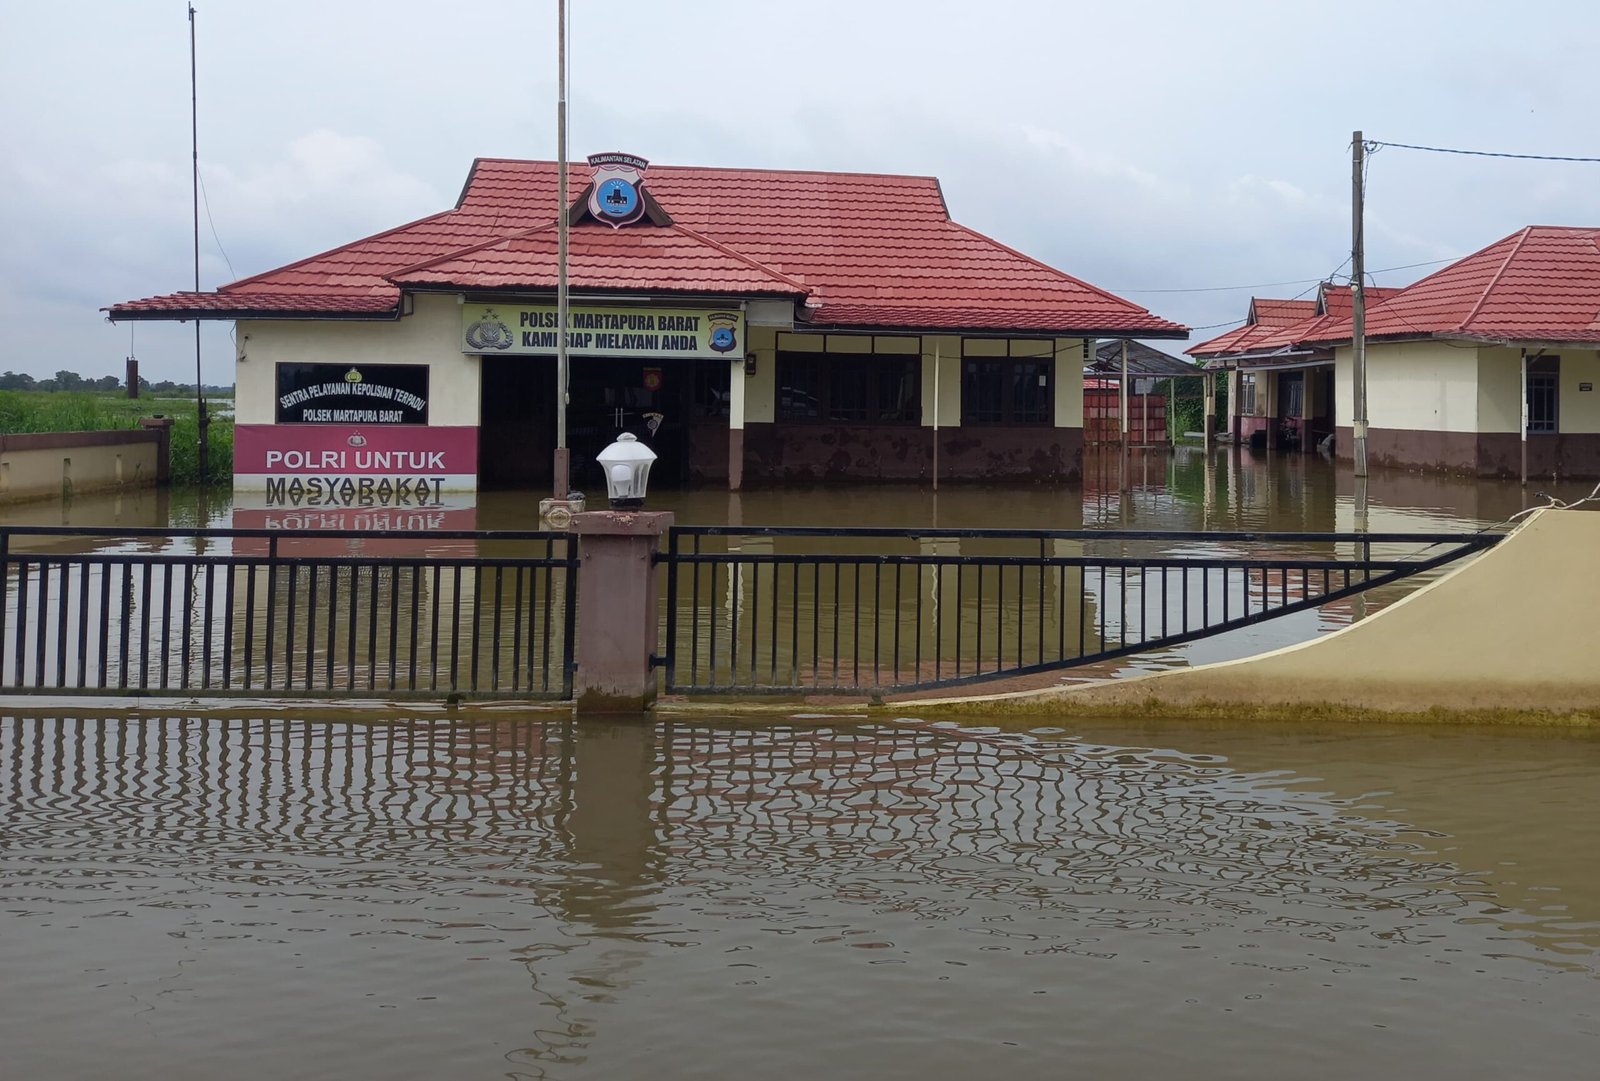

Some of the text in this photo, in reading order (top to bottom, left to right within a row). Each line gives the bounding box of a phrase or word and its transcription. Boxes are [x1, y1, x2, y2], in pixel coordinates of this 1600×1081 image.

[590, 155, 647, 168] KALIMANTAN SELATAN
[573, 313, 655, 331] MARTAPURA
[657, 315, 701, 332] BARAT
[522, 331, 558, 348] KAMI
[595, 333, 659, 350] MELAYANI
[661, 335, 698, 351] ANDA
[279, 382, 426, 411] SENTRA PELAYANAN KEPOLISIAN TERPADU
[302, 409, 404, 423] POLSEK MARTAPURA BARAT
[266, 450, 446, 469] POLRI UNTUK
[266, 477, 446, 493] MASYARAKAT
